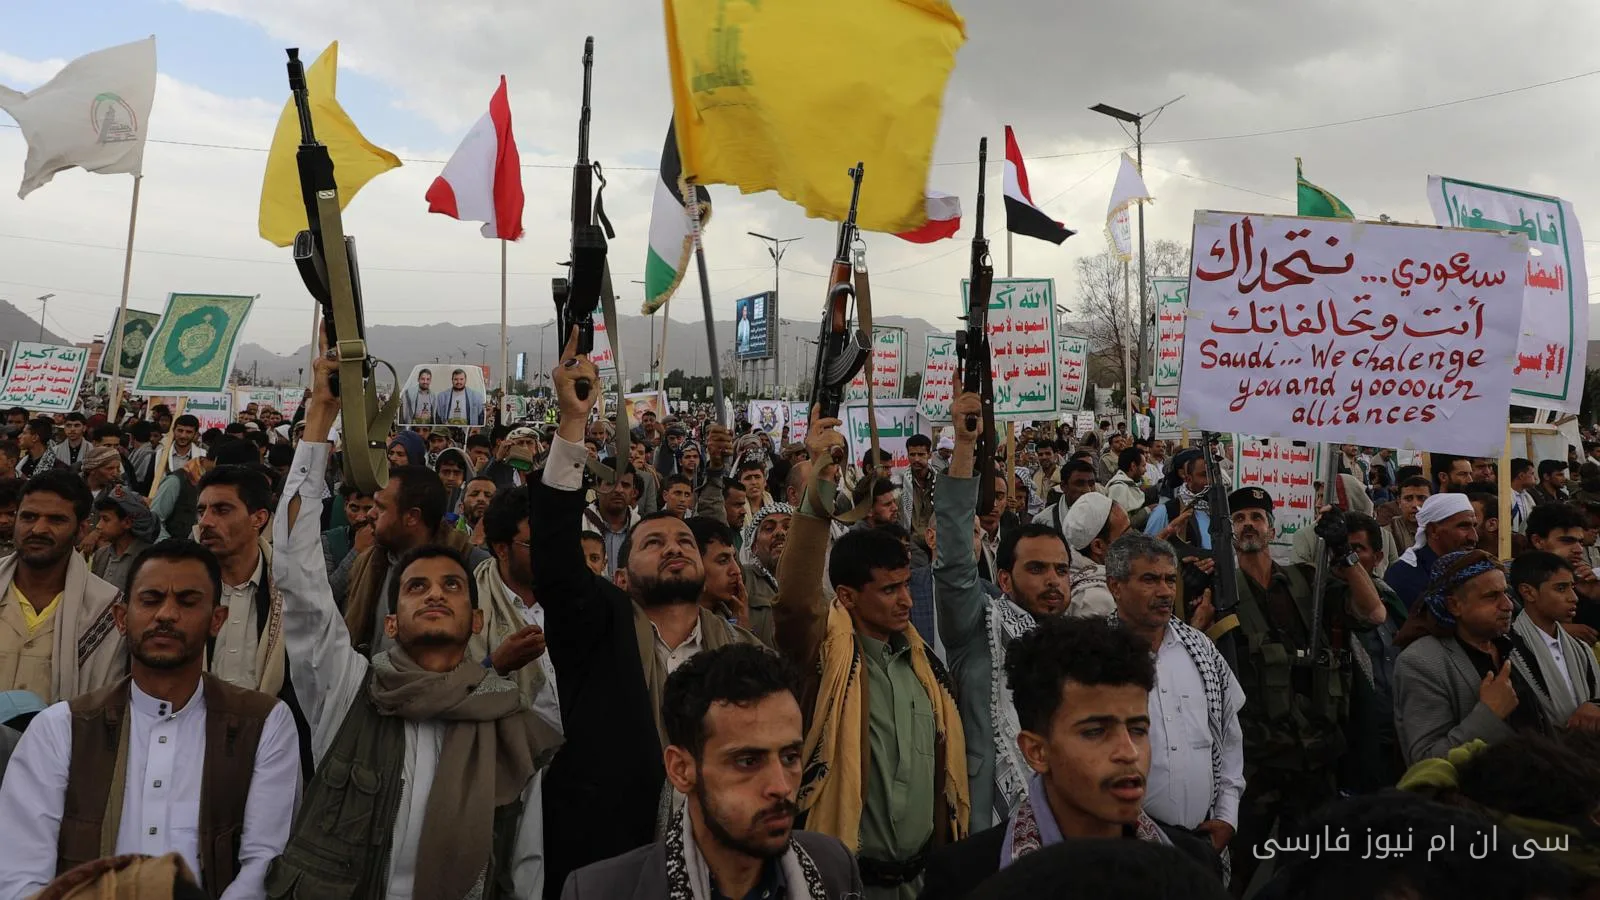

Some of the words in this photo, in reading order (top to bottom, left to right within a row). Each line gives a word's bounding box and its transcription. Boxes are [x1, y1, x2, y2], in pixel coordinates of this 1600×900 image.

[1196, 216, 1354, 294] نتحداك
[1525, 260, 1564, 295] البضا
[1019, 287, 1048, 309] الله
[1015, 317, 1048, 335] الموت
[1211, 294, 1398, 341] وتحالفاتك
[1403, 296, 1485, 339] أنت
[18, 346, 59, 361] أكبر
[58, 348, 84, 361] الله
[1015, 340, 1050, 358] الموت
[1200, 339, 1302, 369] Saudi...
[1312, 339, 1347, 369] We
[1015, 381, 1051, 408] النصر
[1292, 400, 1437, 427] alliances
[1242, 441, 1278, 461] لأمريكا
[1282, 448, 1314, 464] الموت
[1282, 472, 1313, 488] الموت
